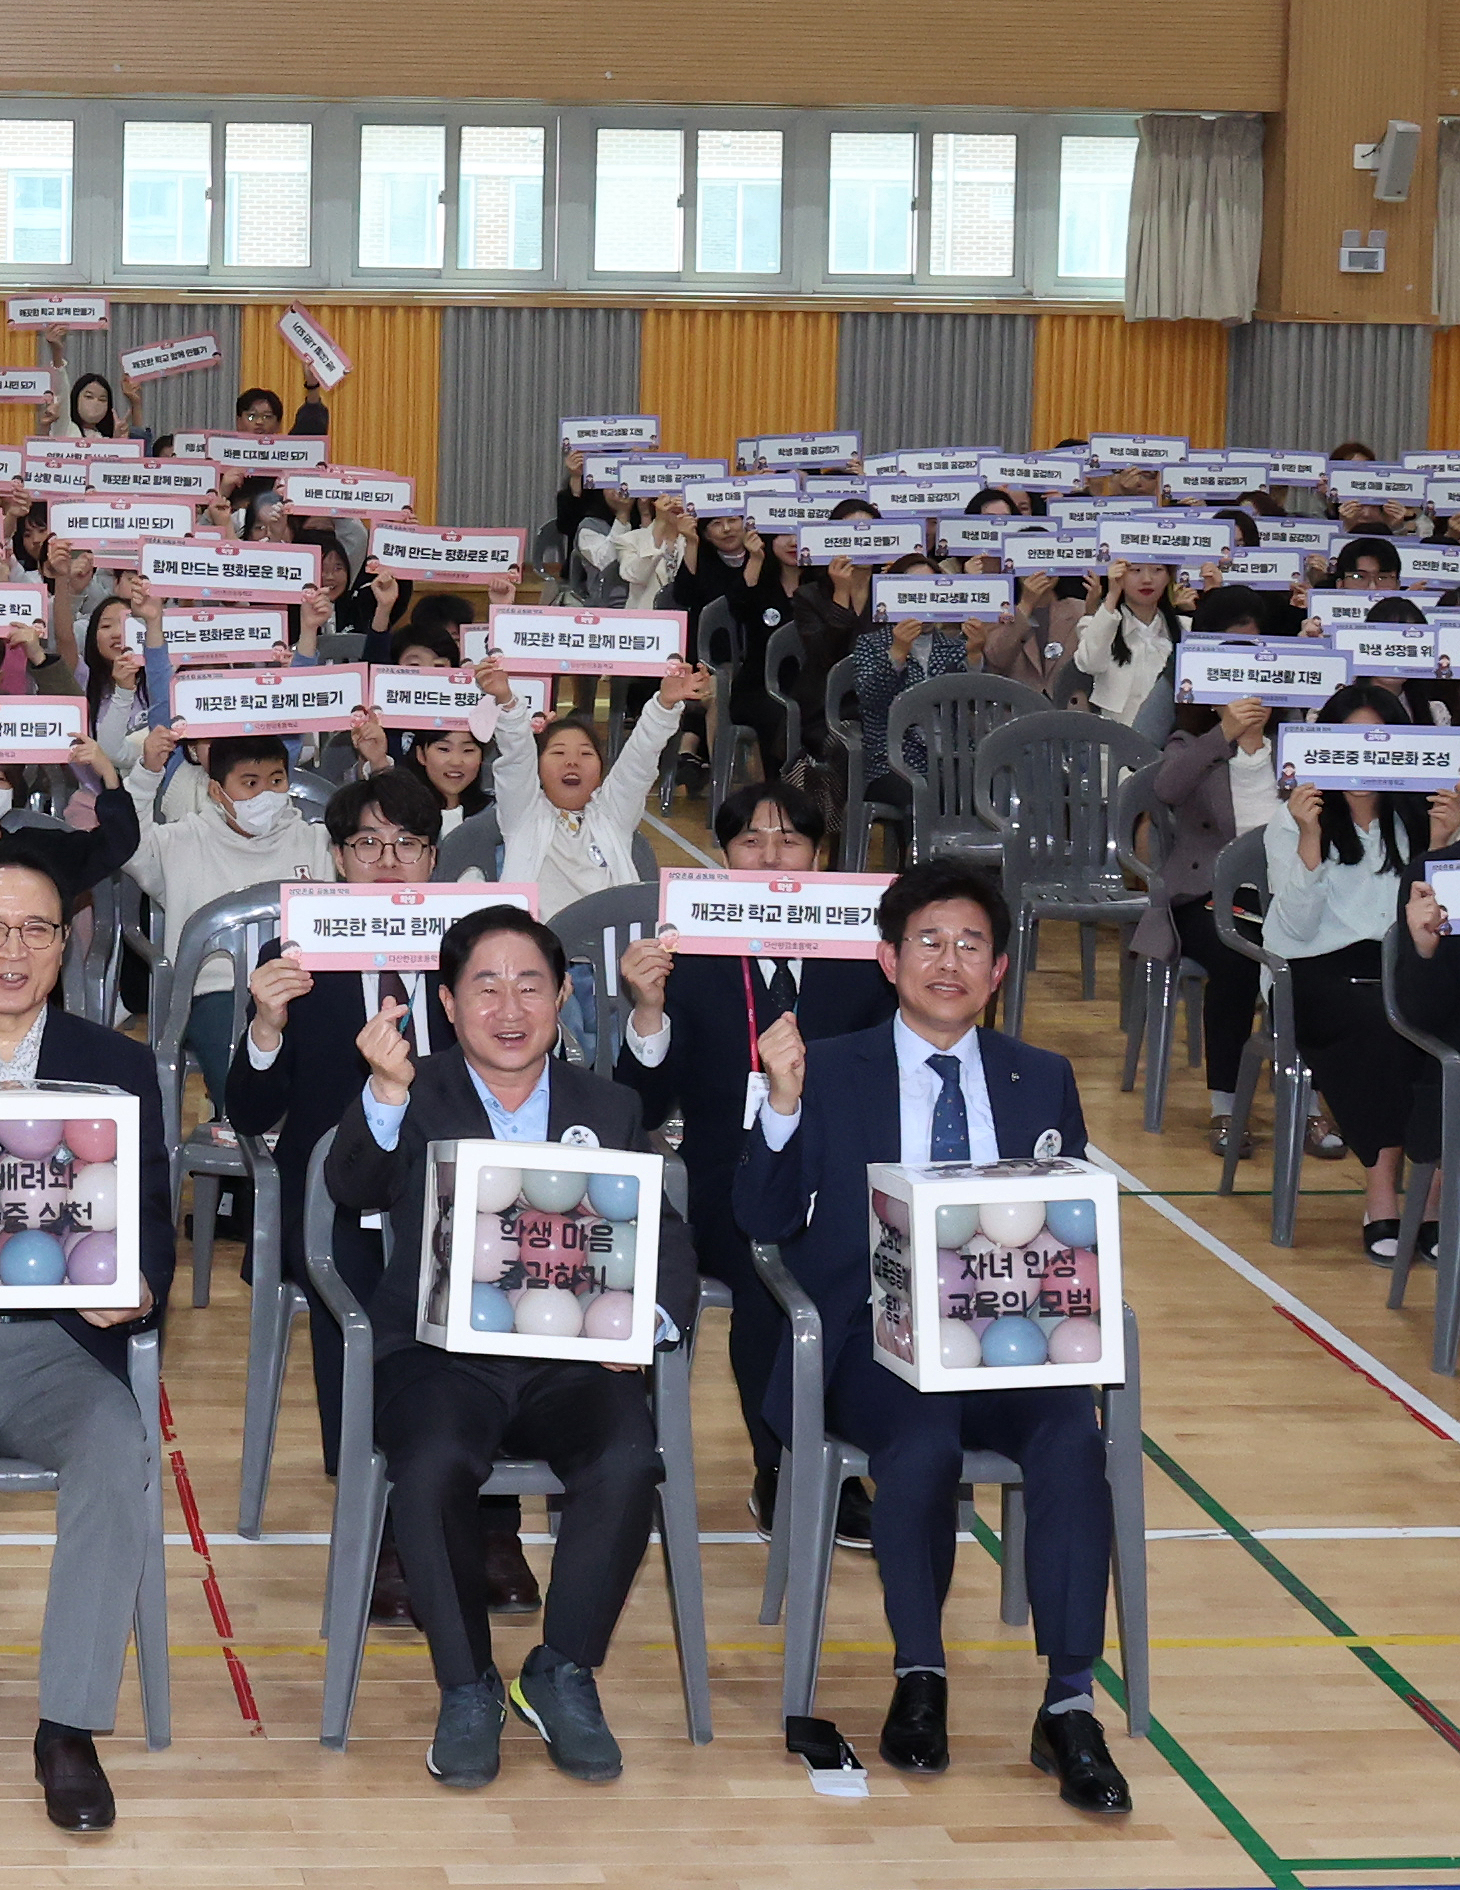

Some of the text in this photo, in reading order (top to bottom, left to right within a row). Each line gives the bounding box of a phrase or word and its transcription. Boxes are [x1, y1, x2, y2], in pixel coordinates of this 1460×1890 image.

[898, 592, 989, 604] 행복한 학교생활 지원
[514, 631, 659, 651] 깨끗한 학교 함께 만들기
[196, 690, 342, 712] 깨끗한 학교 함께 만들기
[21, 722, 61, 738] 만들기
[1305, 749, 1449, 767] 상호존중 학교문화 조성
[314, 916, 443, 937] 깨끗한 학교 함께
[692, 900, 882, 928] 깨끗한 학교 함께 만들기
[39, 1201, 93, 1231] 실천
[499, 1218, 614, 1251] 학생 마음
[499, 1258, 607, 1292] 공감하기
[961, 1249, 1077, 1280] 자녀 인성
[947, 1289, 1091, 1320] 교육의 모범
